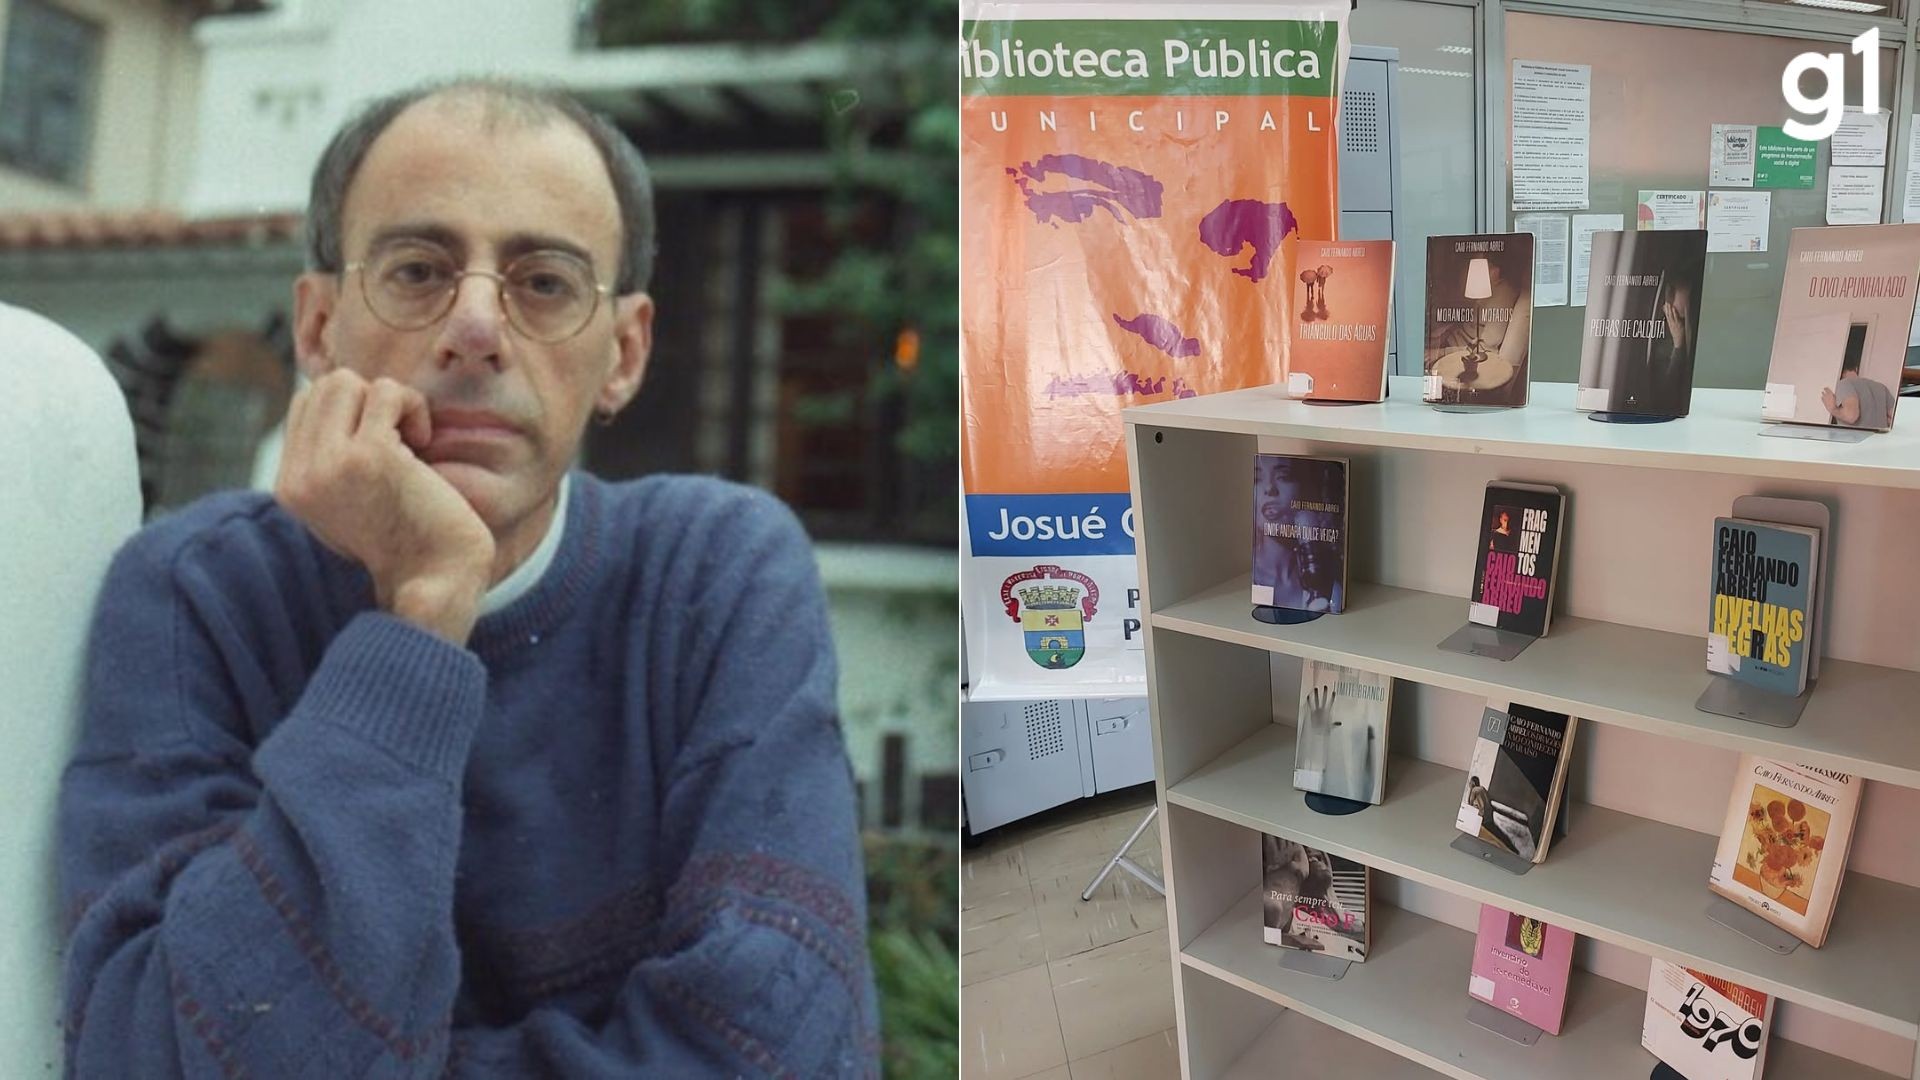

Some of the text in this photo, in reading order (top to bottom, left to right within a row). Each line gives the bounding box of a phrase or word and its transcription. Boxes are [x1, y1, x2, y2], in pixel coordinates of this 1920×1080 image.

[1164, 38, 1321, 79] Pública
[1455, 241, 1504, 252] CAIO FERNANDO ABREU
[1800, 250, 1864, 262] CAIO FERNANDO ABREU
[1604, 275, 1659, 287] CAIO FERNANDO ABREU
[1808, 276, 1907, 298] O OVO APUNHALADO
[1437, 308, 1513, 322] MORANGOS MOFADOS
[1339, 324, 1352, 341] DAS
[1354, 323, 1376, 341] ÁGUAS
[1591, 317, 1666, 338] PEDRAS DE CALCUTÁ
[1291, 500, 1339, 513] CAIO FERNANDO ABREU
[988, 506, 1107, 541] Josué
[1264, 522, 1279, 536] ONDE
[1522, 508, 1548, 533] FRAG
[1519, 531, 1542, 555] MEN
[1719, 526, 1757, 554] CAIO
[1486, 551, 1516, 577] CAIO
[1517, 552, 1537, 577] TOS
[1717, 551, 1799, 587] FERNANDO
[1716, 574, 1767, 603] ABREU
[1715, 594, 1803, 641] OVELHAS
[1357, 683, 1385, 702] BRANCO
[1510, 715, 1561, 739] CAIO FERNANDO
[1773, 772, 1813, 795] FERNANDO
[1271, 890, 1292, 902] Para
[1294, 895, 1327, 908] sempre
[1295, 904, 1339, 928] Caio
[1520, 966, 1530, 977] do
[1679, 982, 1762, 1059] 1970
